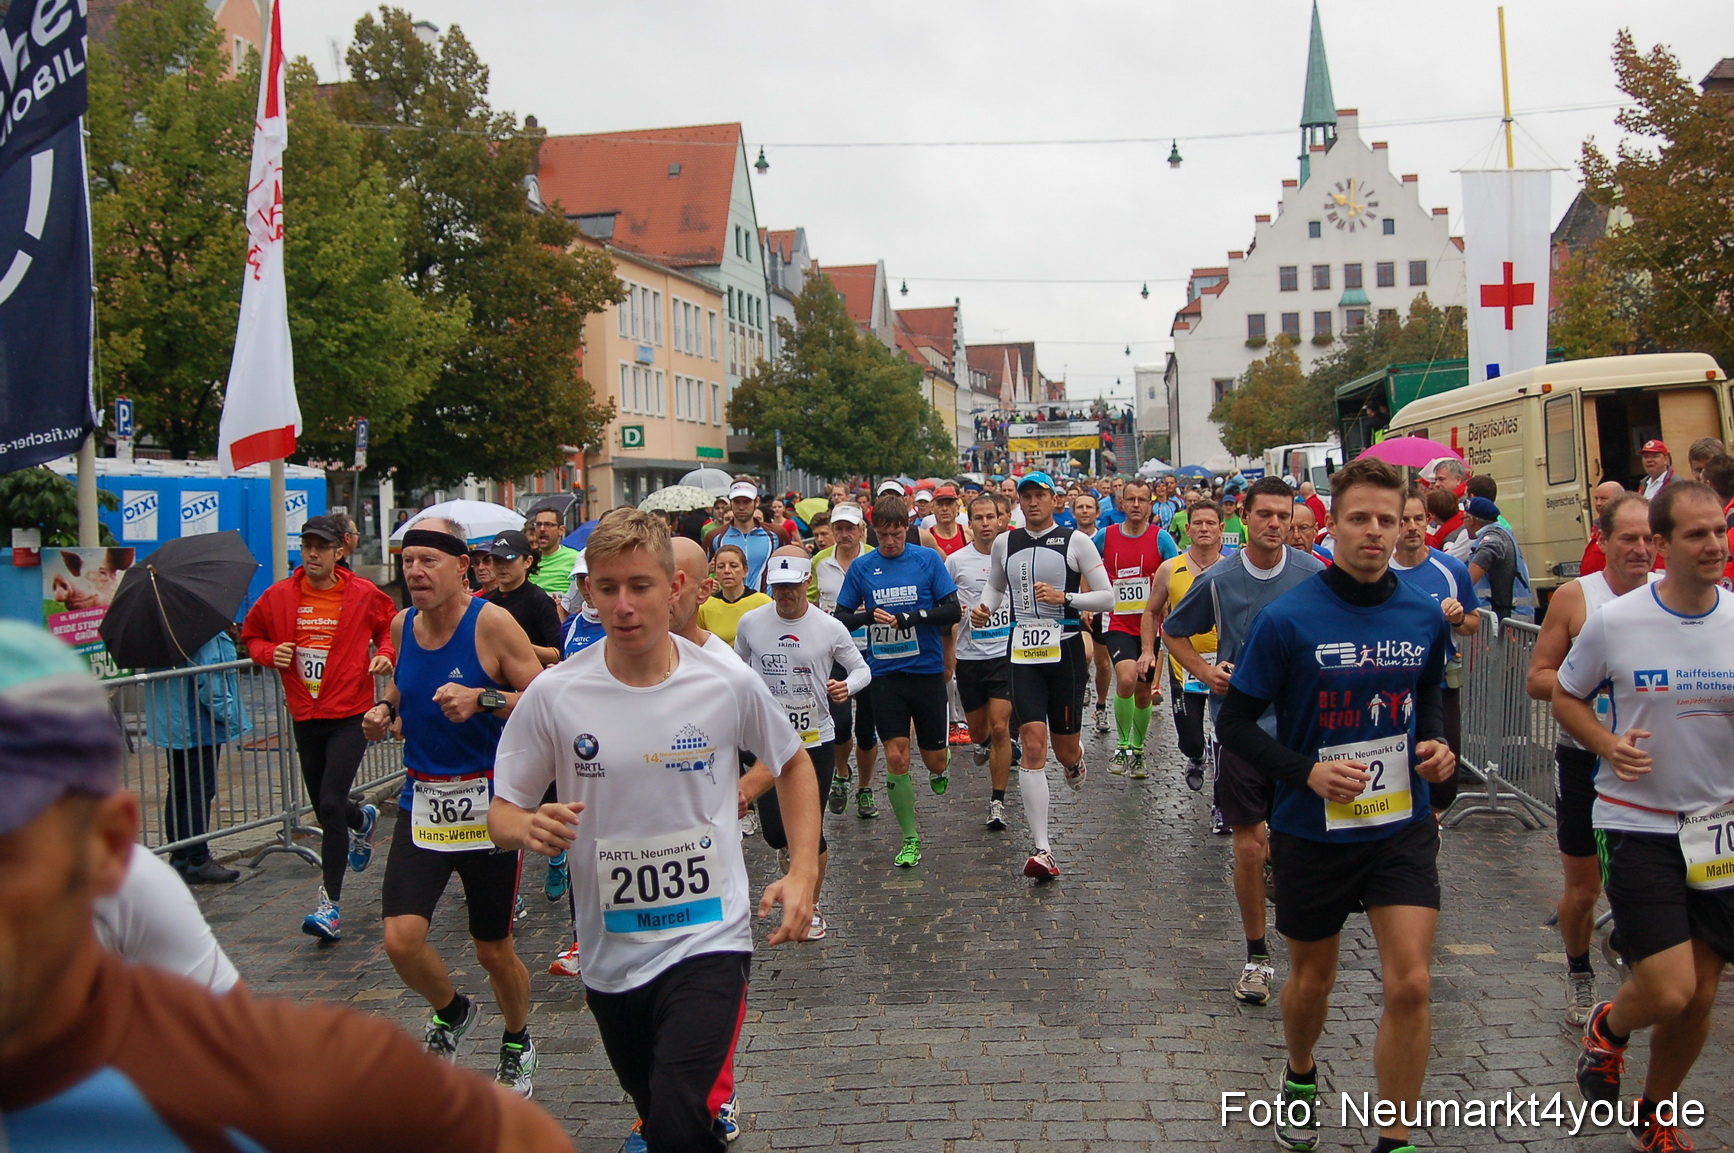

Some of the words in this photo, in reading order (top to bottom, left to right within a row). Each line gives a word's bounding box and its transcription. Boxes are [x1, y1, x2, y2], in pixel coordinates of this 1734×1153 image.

[1468, 416, 1518, 444] Bayerisches
[1037, 440, 1069, 449] START
[1468, 447, 1492, 465] Rotes
[123, 495, 158, 520] DIXI
[181, 496, 218, 520] DIXI
[285, 494, 307, 511] IXI
[872, 585, 918, 600] HUBER
[1119, 586, 1143, 601] 530
[1022, 629, 1050, 647] 502
[880, 644, 909, 653] Christoph
[1376, 640, 1425, 658] HiRo
[1376, 658, 1400, 667] Run
[1319, 691, 1338, 709] BE
[1343, 690, 1352, 707] A
[1319, 710, 1360, 729] HERO!
[1321, 753, 1354, 763] PARTL
[1355, 746, 1393, 760] Neumarkt
[574, 762, 605, 772] PARTL
[428, 797, 475, 824] 362
[1354, 798, 1389, 816] Daniel
[419, 829, 487, 841] Hans-Werner
[599, 850, 638, 861] PARTL
[641, 842, 696, 859] Neumarkt
[610, 855, 710, 905] 2035
[637, 908, 691, 928] Marcel
